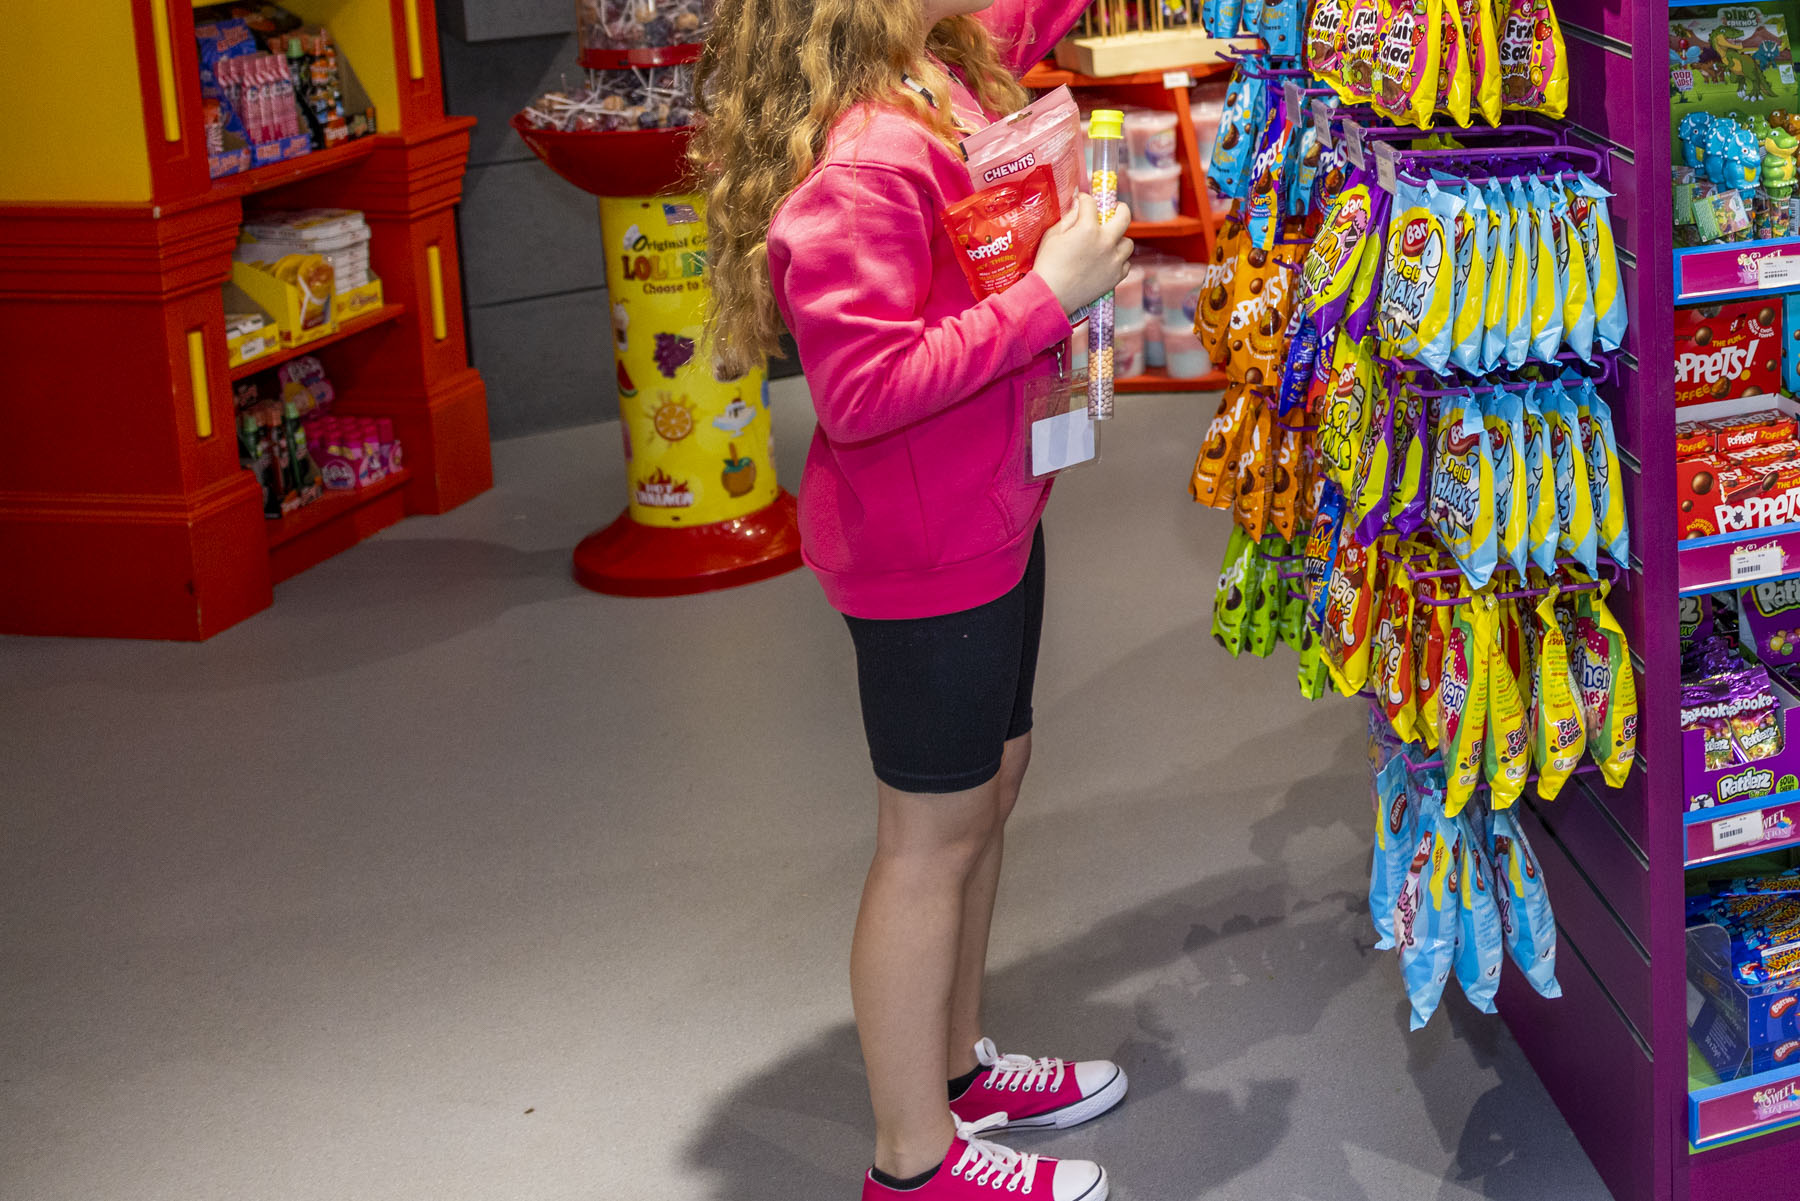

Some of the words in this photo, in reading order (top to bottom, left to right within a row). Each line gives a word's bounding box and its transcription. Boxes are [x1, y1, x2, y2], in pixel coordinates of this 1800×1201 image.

[633, 234, 689, 253] Original
[643, 281, 680, 295] Choose
[686, 282, 699, 292] to
[1760, 426, 1791, 440] TOFFEE
[1677, 438, 1708, 453] TOFFEE
[1448, 459, 1471, 483] Jelly
[1436, 473, 1480, 522] HARKS
[1719, 771, 1773, 799] Rattlerz
[1779, 776, 1795, 786] SOUR
[1772, 996, 1798, 1014] Barratt
